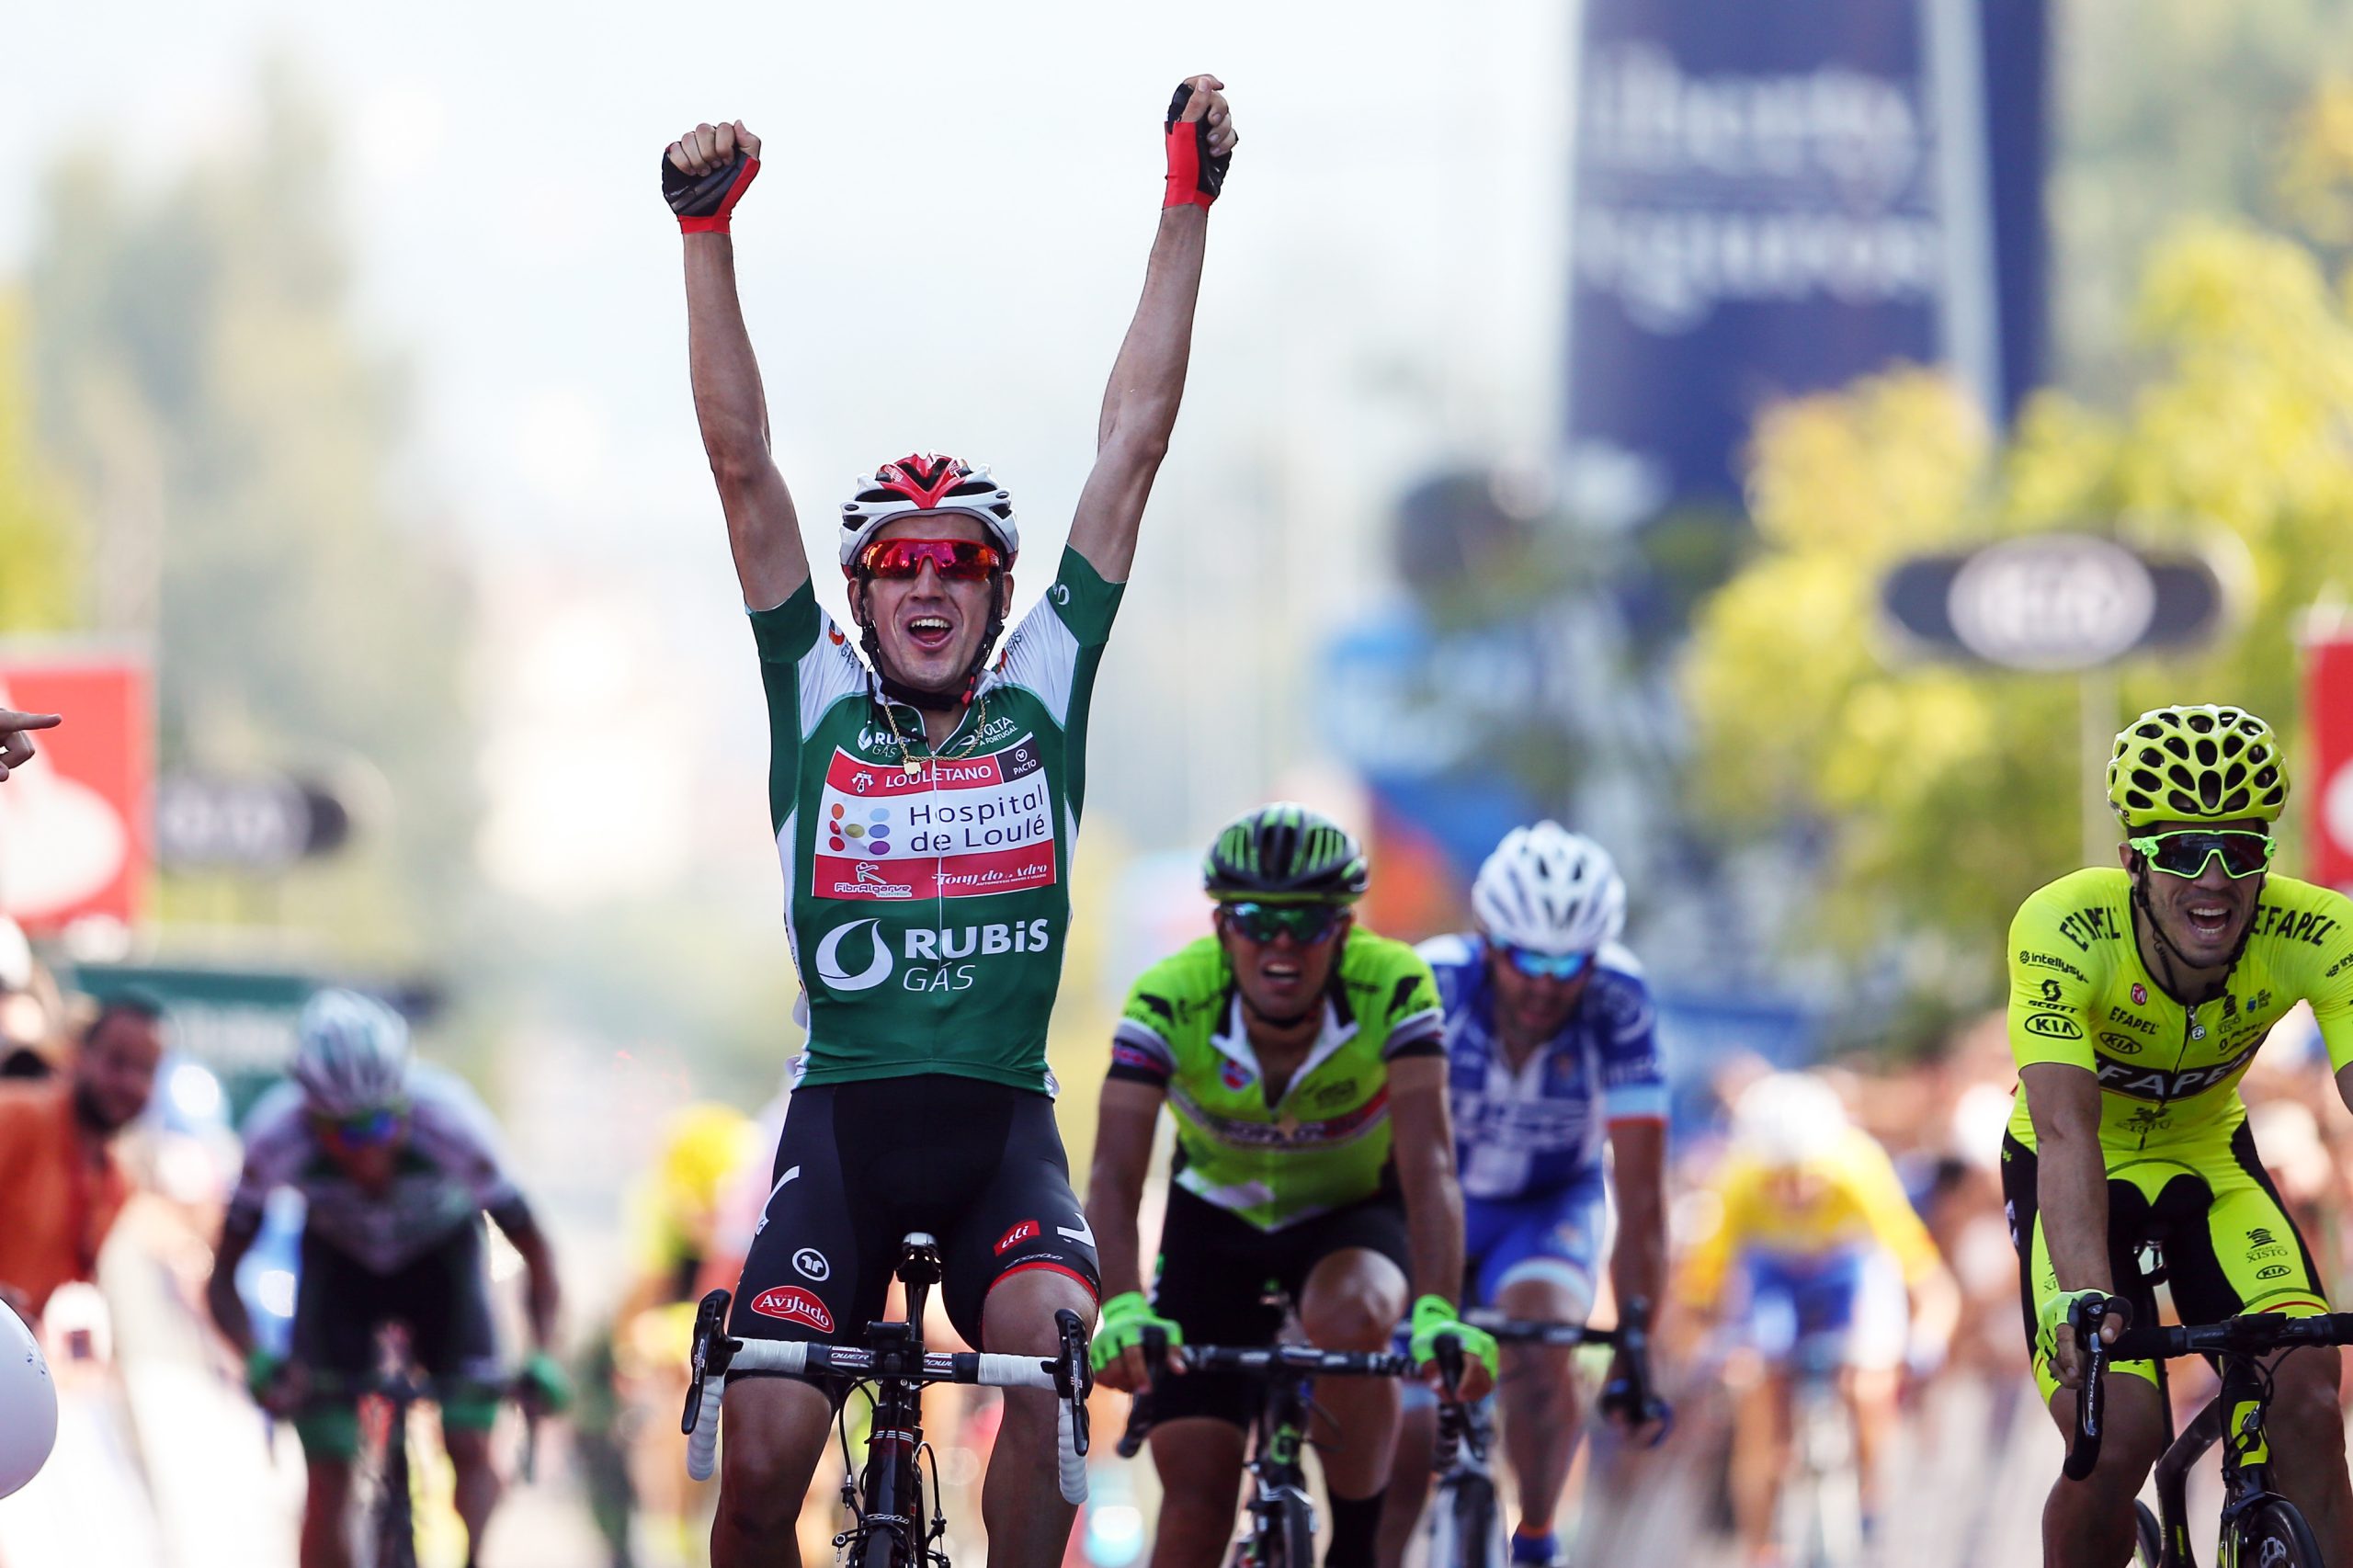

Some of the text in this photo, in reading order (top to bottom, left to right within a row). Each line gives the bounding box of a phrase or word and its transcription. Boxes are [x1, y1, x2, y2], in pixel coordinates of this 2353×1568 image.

[985, 724, 1019, 744] PORTUGAL
[886, 766, 992, 788] LOULETANO
[1013, 759, 1037, 776] PACTO
[910, 784, 1044, 825] Hospital
[911, 814, 1045, 852] de Loulé
[903, 962, 975, 992] GÁS
[2028, 1000, 2078, 1013] SCOTT
[2035, 1018, 2075, 1036] KIA
[2109, 1006, 2157, 1035] EFAPEL
[2106, 1036, 2134, 1052] KIA
[2097, 1051, 2250, 1096] FAPEL
